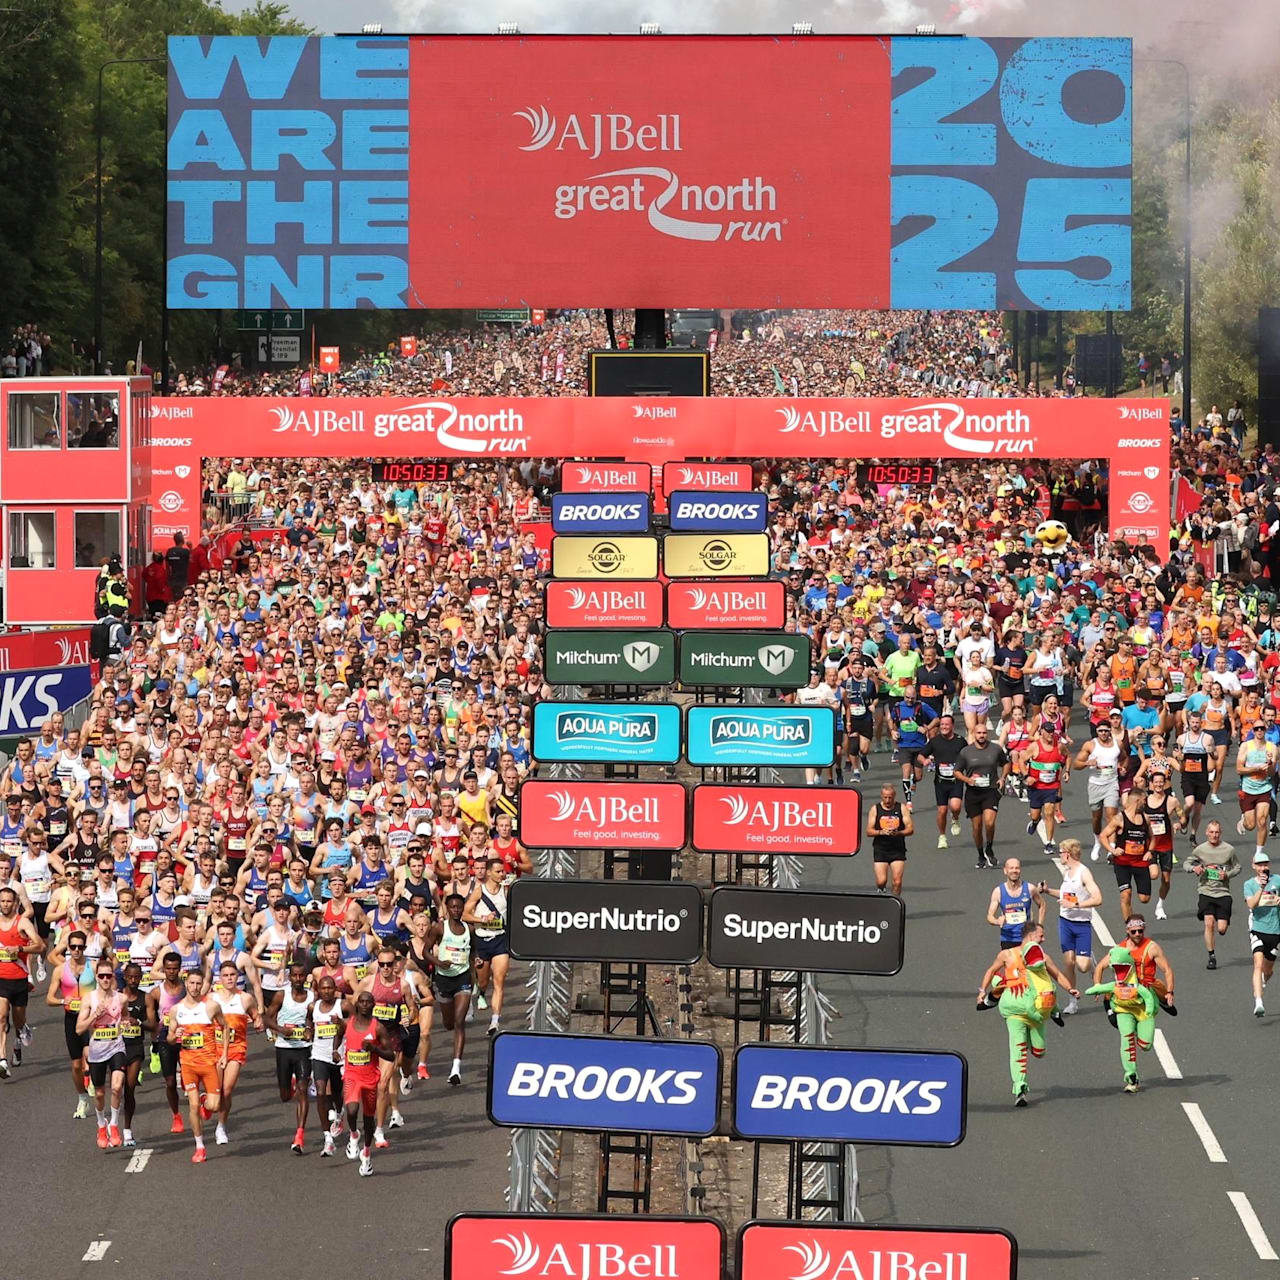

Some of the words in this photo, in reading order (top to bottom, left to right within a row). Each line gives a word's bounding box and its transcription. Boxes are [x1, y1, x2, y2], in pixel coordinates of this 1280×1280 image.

[170, 36, 408, 99] WE
[890, 37, 1131, 167] 20
[168, 109, 408, 171] ARE
[556, 114, 683, 159] AJBell
[554, 178, 645, 219] great
[682, 177, 776, 210] north
[168, 181, 408, 244] THE
[724, 221, 783, 241] run
[890, 175, 1131, 310] 25
[168, 254, 408, 309] GNR
[294, 410, 365, 436] AJBell
[374, 409, 435, 437] great
[459, 409, 523, 432] north
[800, 410, 872, 437] AJBell
[880, 410, 942, 438] great
[965, 409, 1030, 433] north
[488, 437, 527, 452] run
[994, 438, 1034, 453] run
[1118, 439, 1162, 448] BROOKS
[383, 464, 448, 481] 10:50:33
[591, 471, 637, 487] AJBell
[693, 471, 738, 487] AJBell
[868, 466, 934, 483] 10:50:33
[559, 505, 642, 521] BROOKS
[677, 503, 760, 520] BROOKS
[587, 553, 625, 561] SOLGAR
[699, 551, 736, 560] SOLGAR
[585, 591, 646, 613] AJBell
[707, 592, 767, 614] AJBell
[556, 650, 619, 665] Mitchum
[691, 652, 753, 667] Mitchum
[562, 717, 606, 735] AQUA
[609, 721, 651, 738] PURA
[716, 721, 760, 739] AQUA
[762, 724, 805, 741] PURA
[575, 797, 659, 827] AJBell
[748, 801, 833, 832] AJBell
[573, 829, 592, 839] Feel
[593, 830, 618, 841] good,
[620, 830, 662, 841] investing.
[746, 833, 765, 843] Feel
[766, 834, 791, 846] good,
[793, 835, 834, 846] investing.
[507, 1062, 703, 1105] BROOKS
[750, 1075, 948, 1116] BROOKS
[539, 1243, 679, 1280] AJBell
